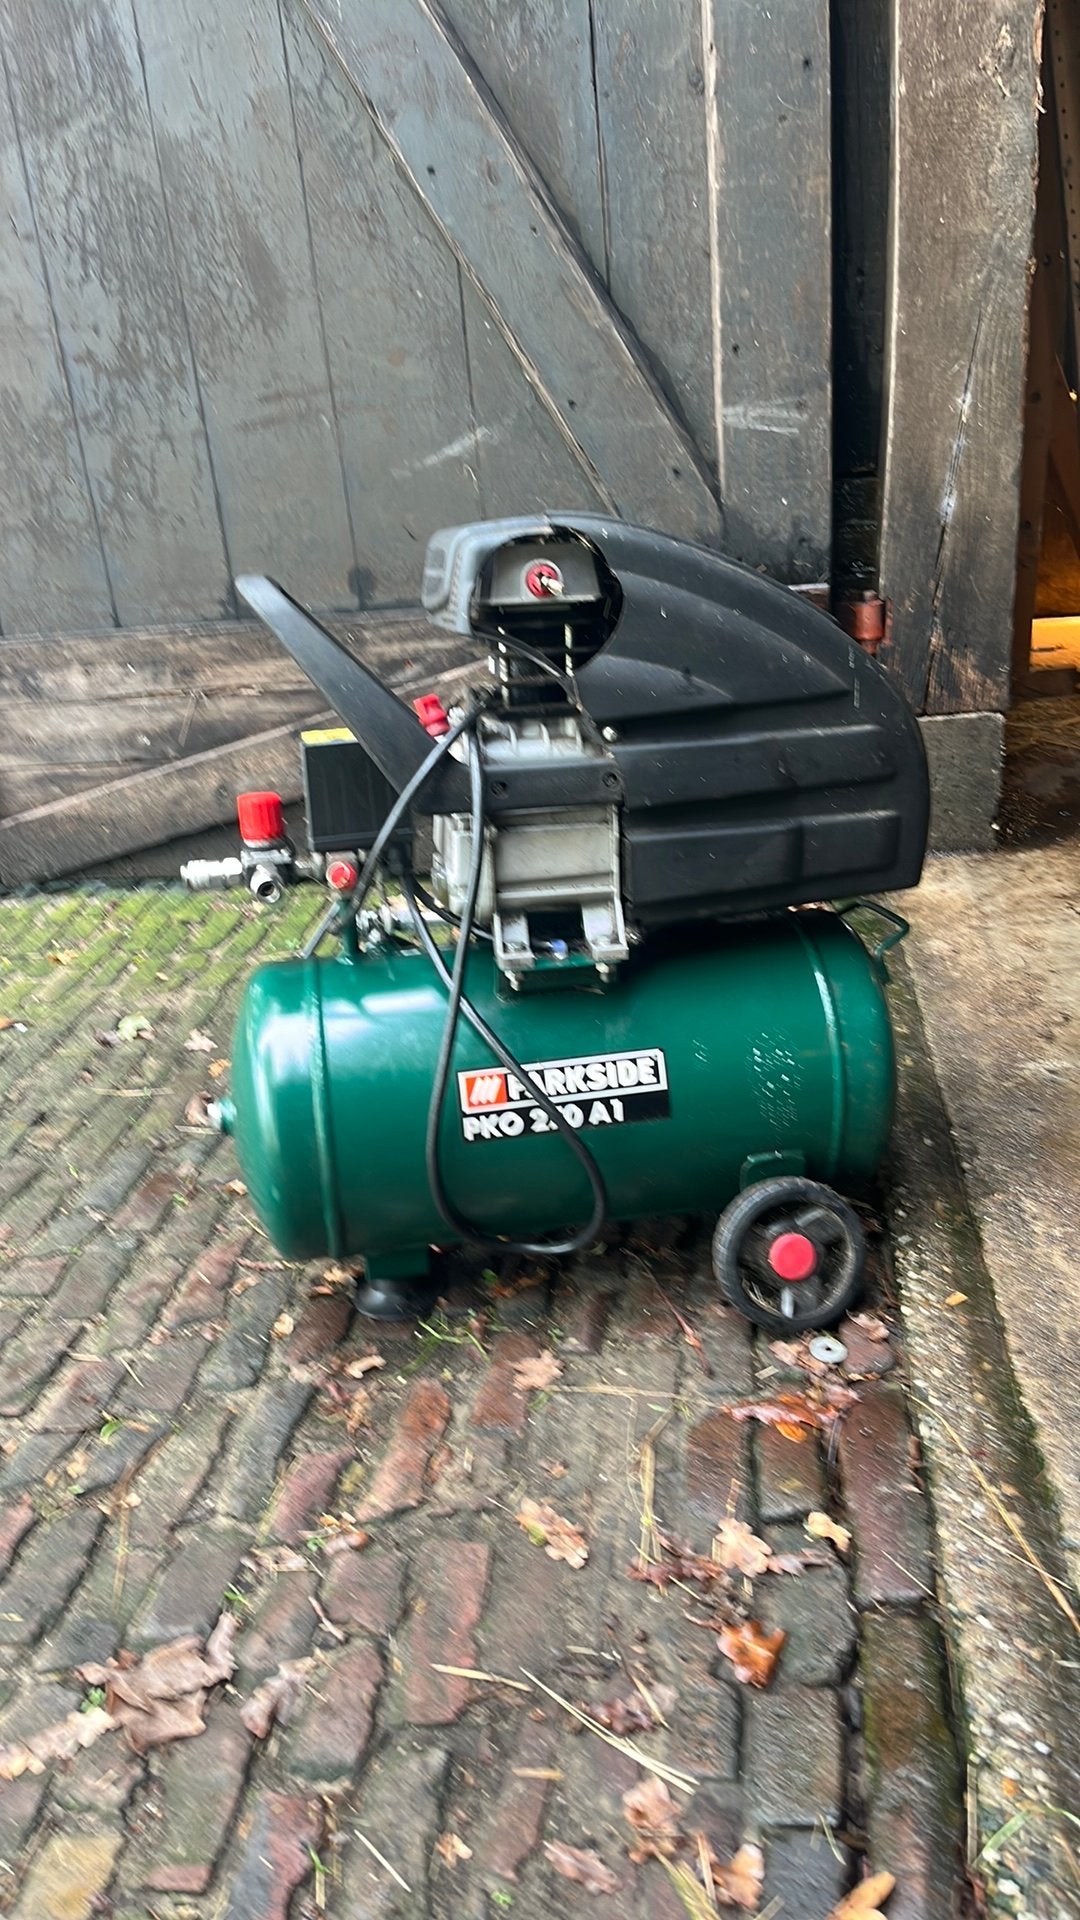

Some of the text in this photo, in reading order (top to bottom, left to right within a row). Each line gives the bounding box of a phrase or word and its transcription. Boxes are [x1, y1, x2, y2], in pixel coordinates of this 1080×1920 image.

[462, 1098, 625, 1141] PKO 20 A1
